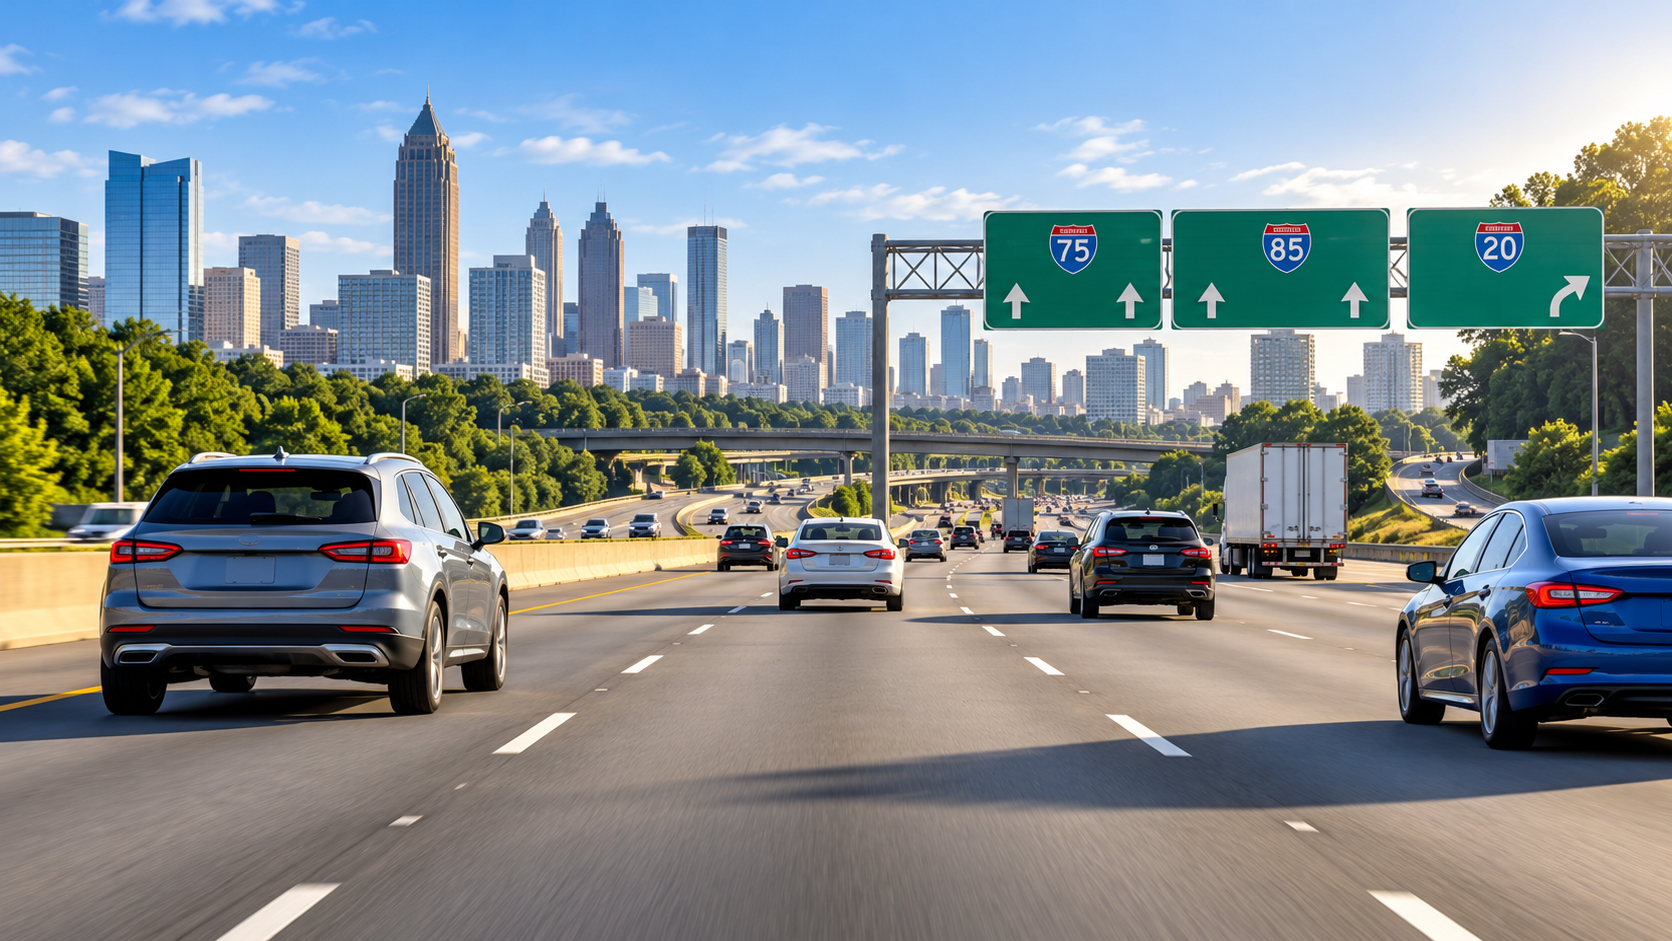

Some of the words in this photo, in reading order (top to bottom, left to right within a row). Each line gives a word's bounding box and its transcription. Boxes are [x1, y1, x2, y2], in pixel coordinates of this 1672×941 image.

[1057, 239, 1089, 262] 75
[1270, 238, 1303, 261] 85
[1483, 236, 1516, 260] 20
